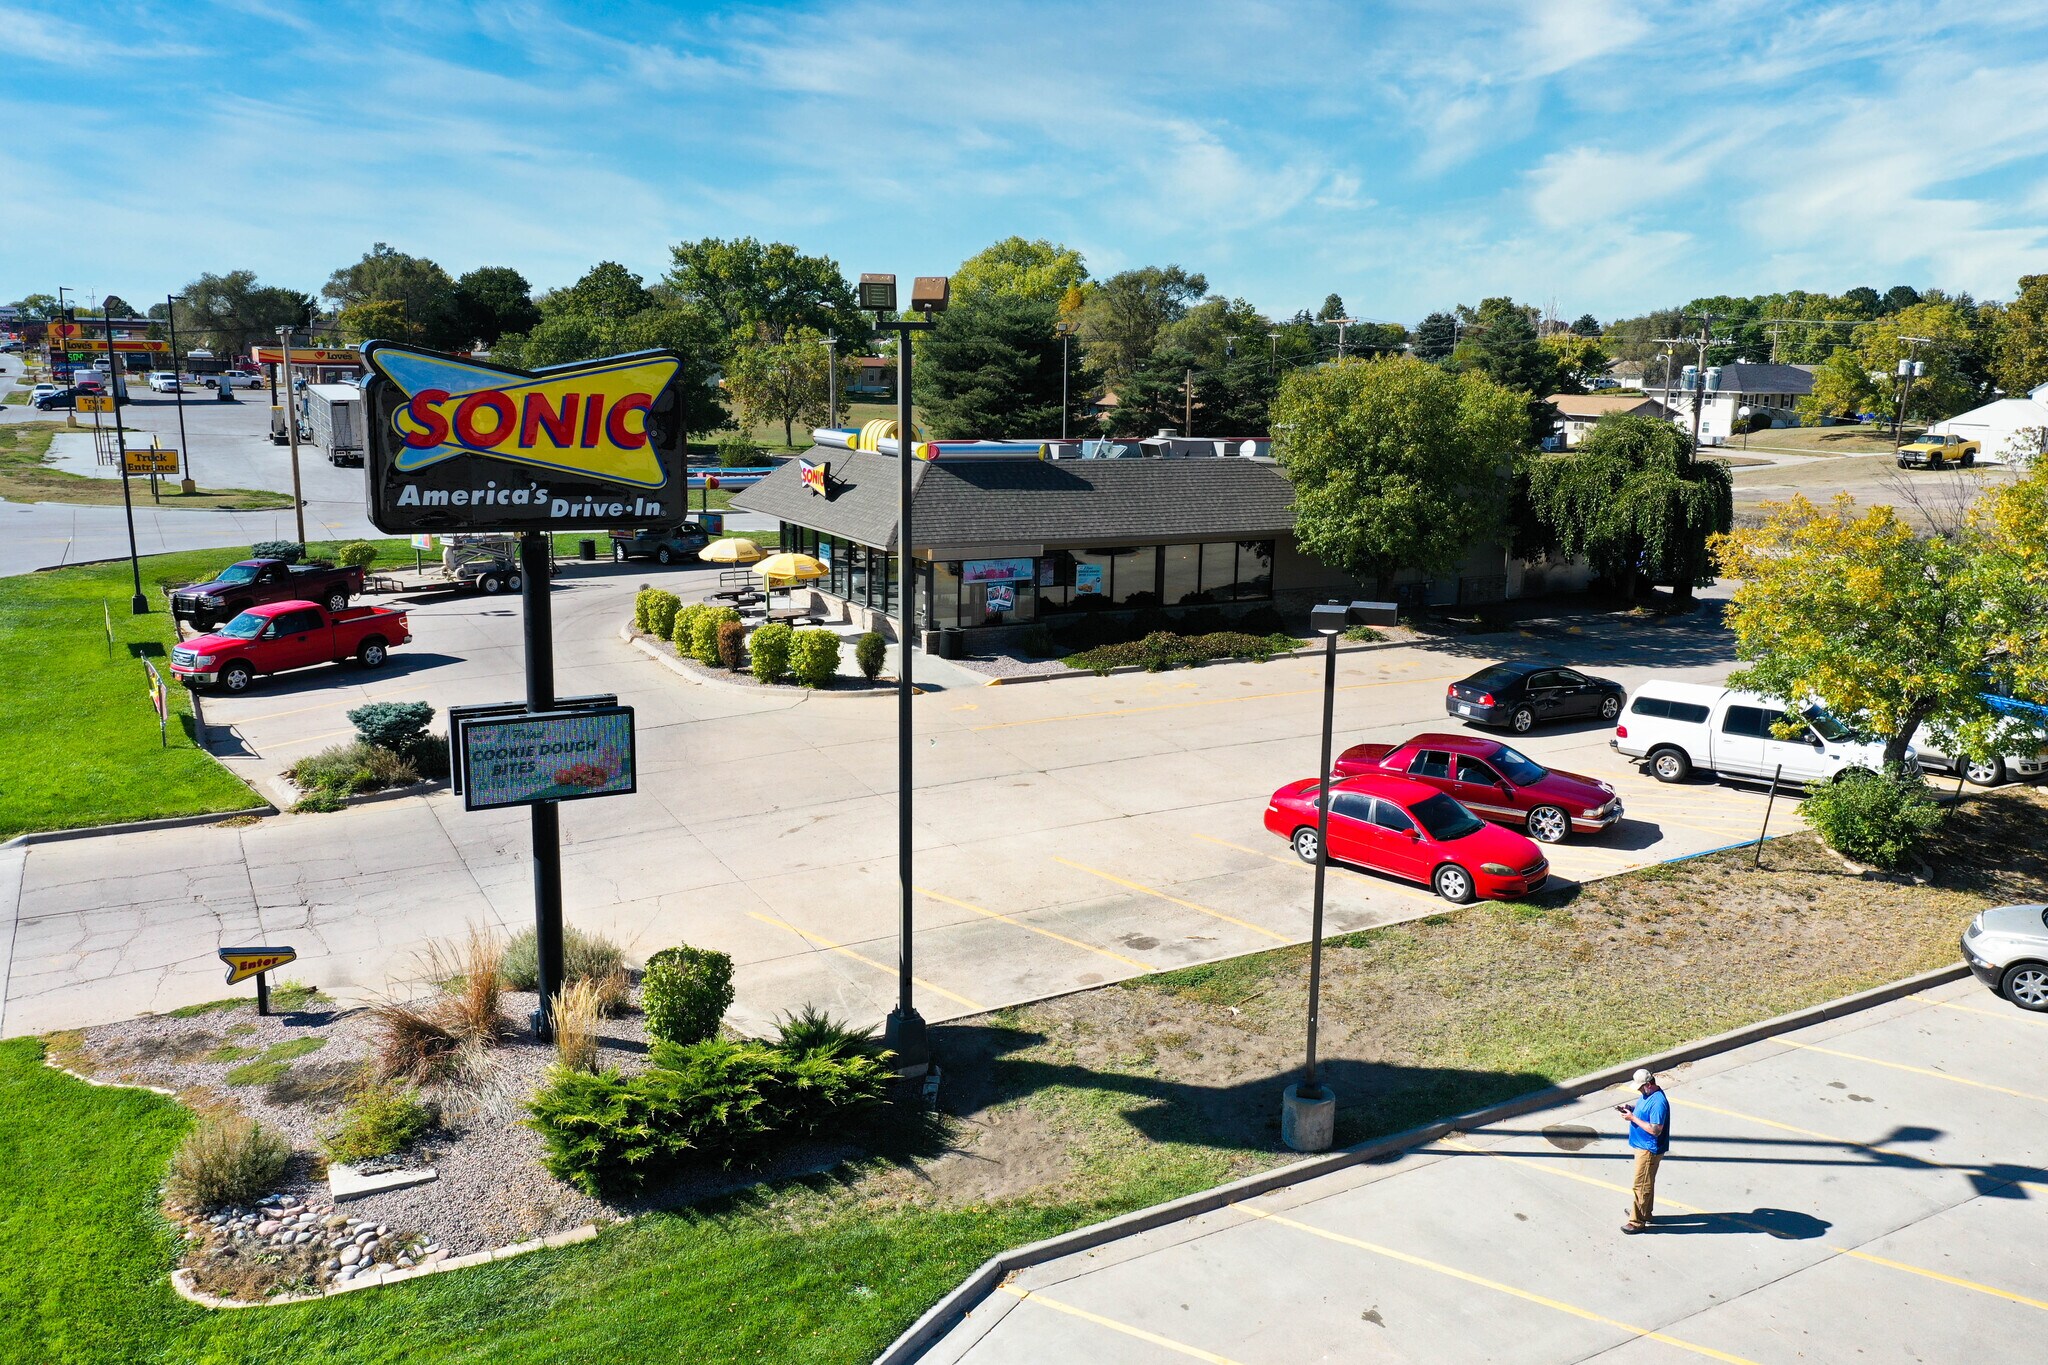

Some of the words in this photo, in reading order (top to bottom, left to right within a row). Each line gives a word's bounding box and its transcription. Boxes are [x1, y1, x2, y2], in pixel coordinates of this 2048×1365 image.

[327, 351, 353, 360] Love's
[401, 388, 653, 450] SONIC
[135, 453, 167, 462] Truck
[802, 467, 825, 487] SONIC
[396, 480, 549, 507] America's
[472, 746, 535, 762] COOKIE
[539, 740, 597, 756] DOUGH
[492, 761, 536, 777] BITES
[239, 956, 279, 971] Enter
